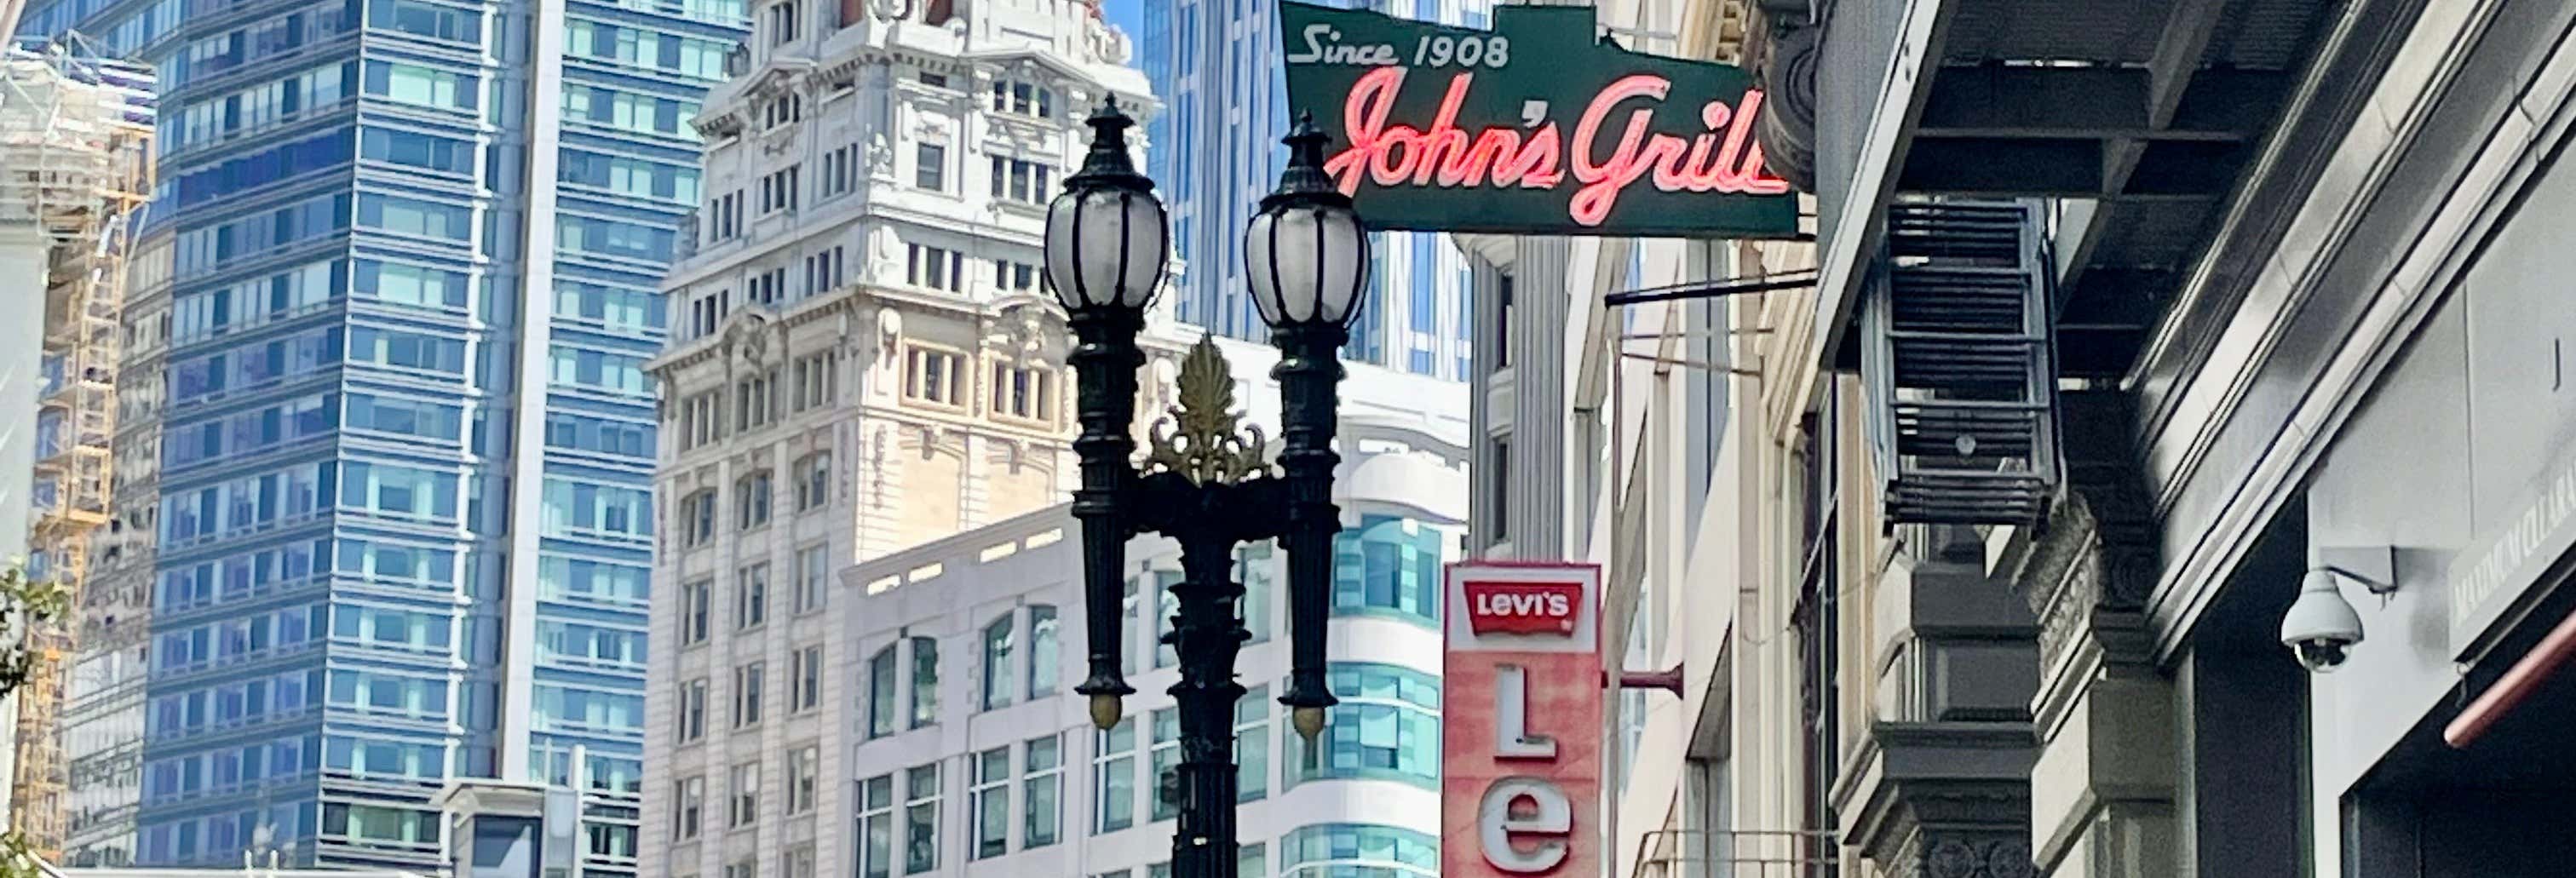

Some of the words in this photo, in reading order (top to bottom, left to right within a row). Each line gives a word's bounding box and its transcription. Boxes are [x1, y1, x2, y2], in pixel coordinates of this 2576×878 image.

[1287, 25, 1399, 66] Since
[1414, 36, 1509, 68] 1908
[1323, 66, 1565, 197] John's
